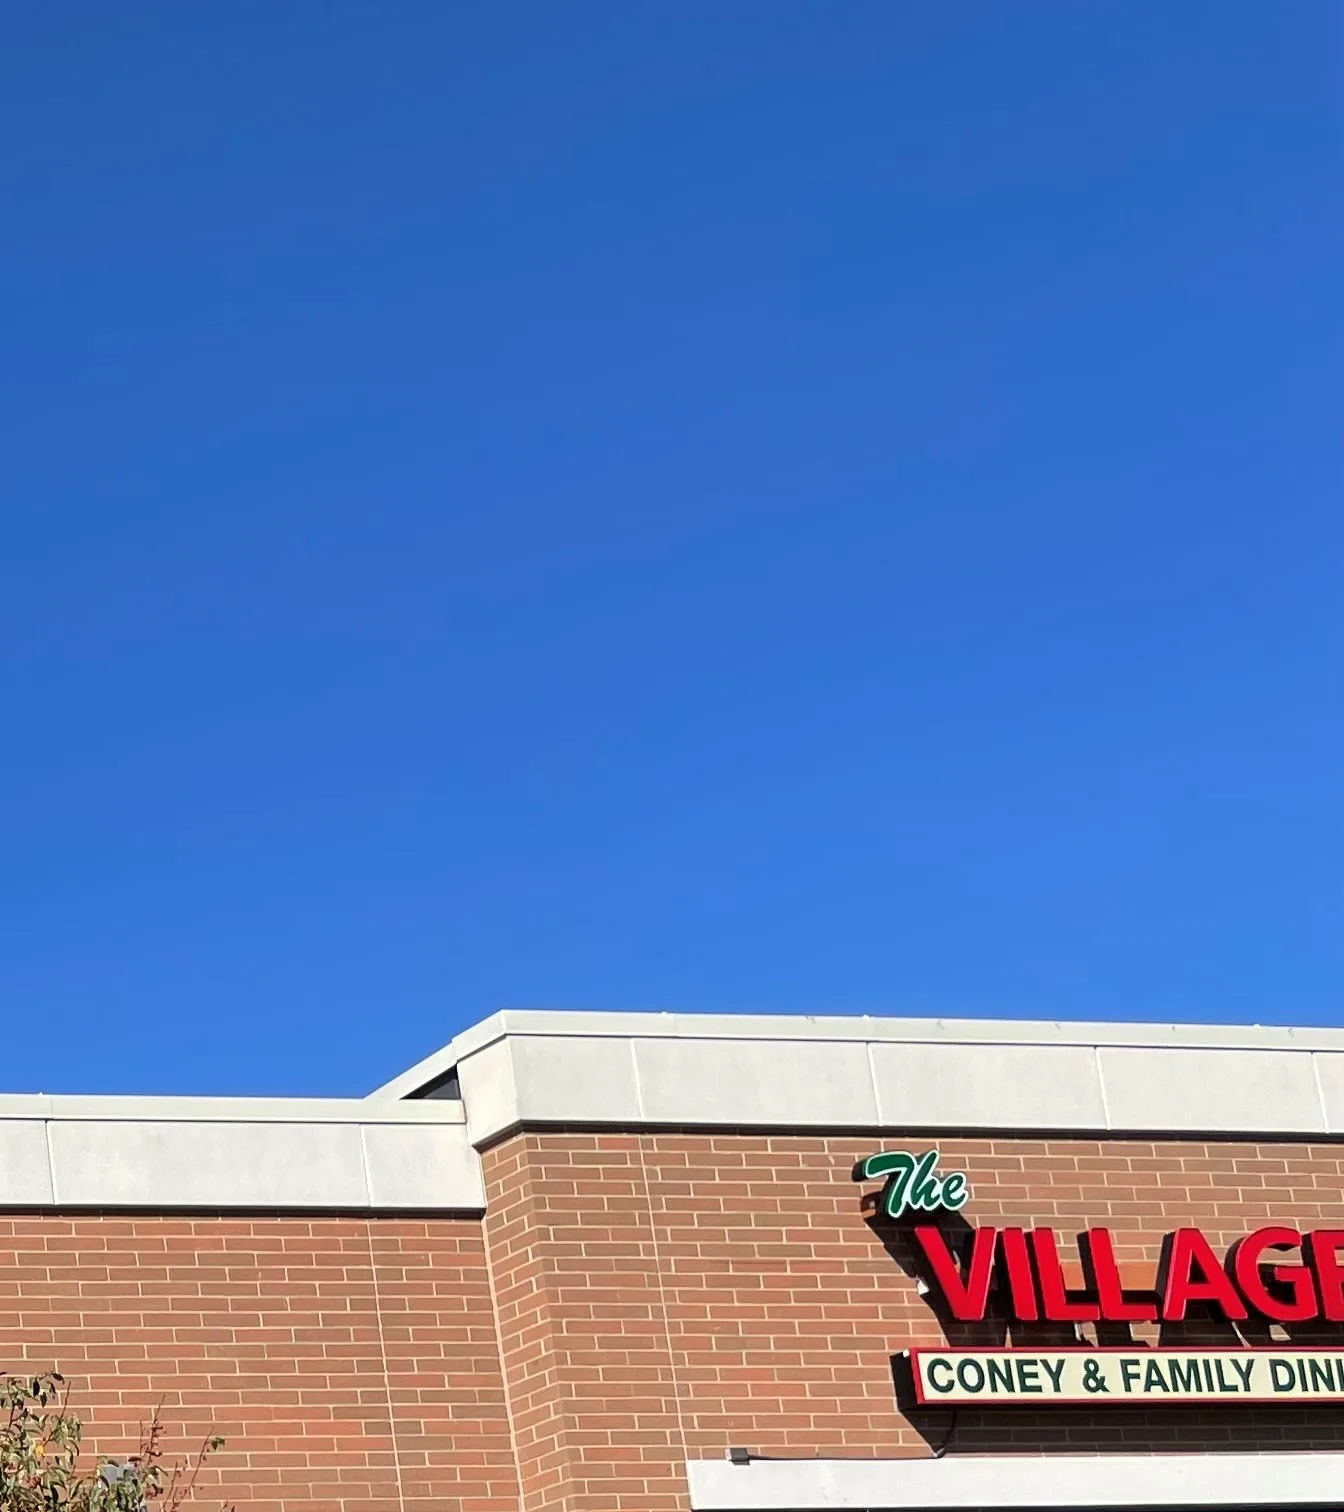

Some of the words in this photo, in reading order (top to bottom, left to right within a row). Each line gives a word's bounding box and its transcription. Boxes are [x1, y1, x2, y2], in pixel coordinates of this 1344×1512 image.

[863, 1148, 970, 1219] The
[926, 1357, 1066, 1394] CONEY
[1081, 1357, 1111, 1394] &
[1119, 1357, 1255, 1393] FAMILY
